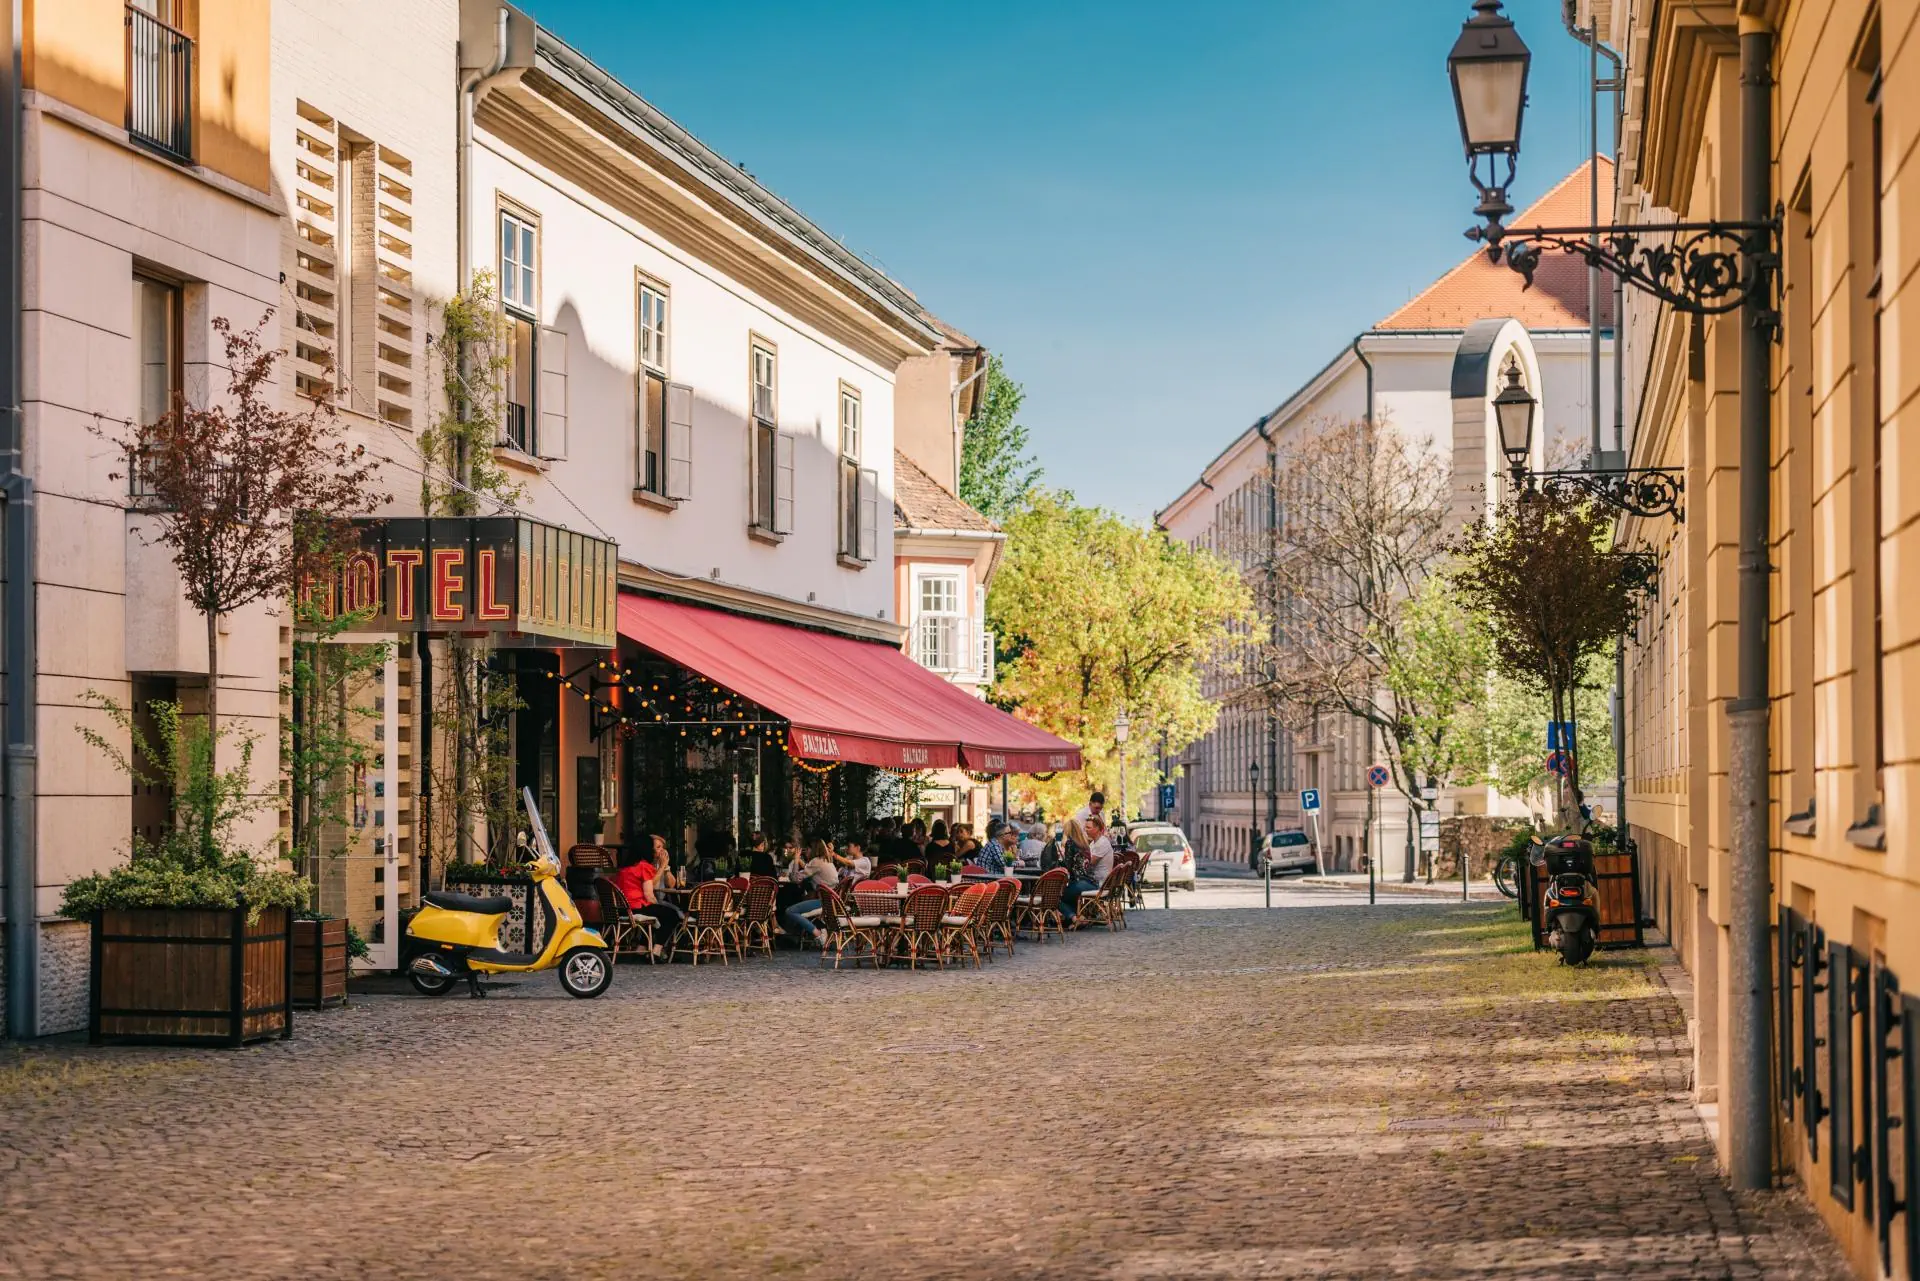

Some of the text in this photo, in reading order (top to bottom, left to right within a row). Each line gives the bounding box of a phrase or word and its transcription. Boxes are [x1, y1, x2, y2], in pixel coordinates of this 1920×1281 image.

[297, 548, 509, 621] HOTEL
[802, 733, 841, 756] BALTAZÁR
[1165, 798, 1172, 807] P
[1305, 792, 1315, 808] P
